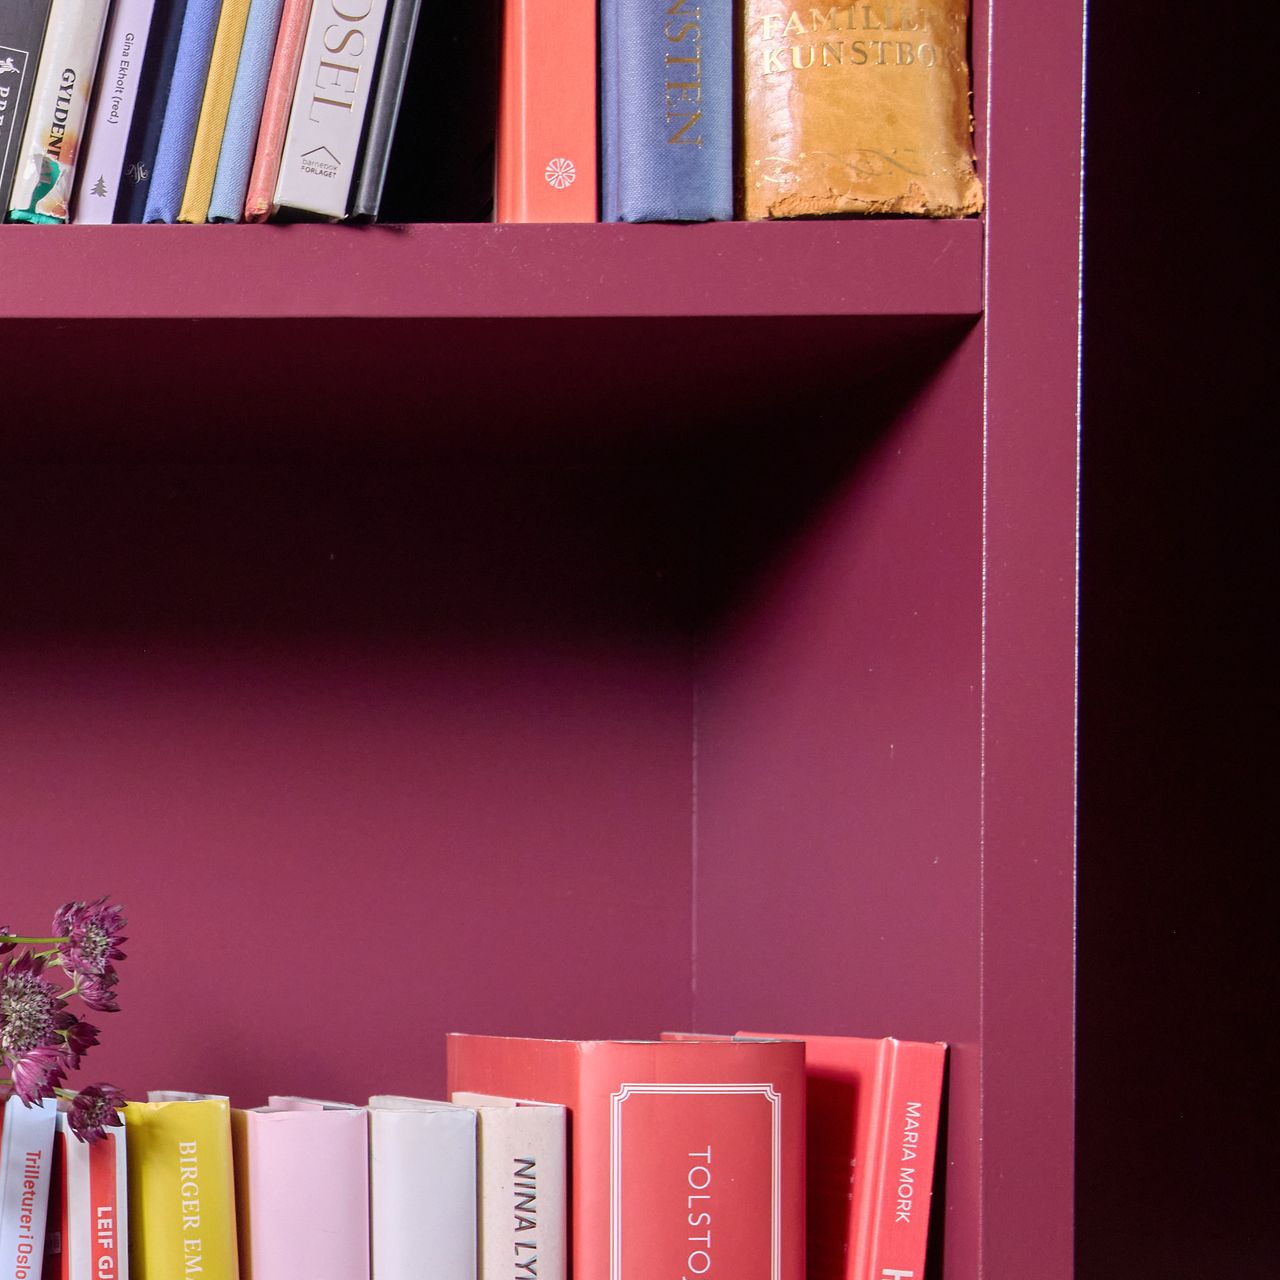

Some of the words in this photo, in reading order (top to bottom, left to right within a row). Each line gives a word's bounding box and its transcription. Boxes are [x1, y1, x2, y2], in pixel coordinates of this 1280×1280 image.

[121, 32, 134, 62] Gina
[115, 63, 130, 95] Ekholt
[106, 96, 124, 125] (red.)
[301, 166, 337, 178] FORLAGET
[901, 1101, 921, 1162] MARIA
[18, 1149, 42, 1234] Trilleturer
[179, 1141, 201, 1230] BIRGER
[513, 1158, 537, 1232] NINA
[895, 1167, 915, 1224] MORK
[97, 1206, 114, 1251] LEIF
[14, 1243, 33, 1280] Oslo
